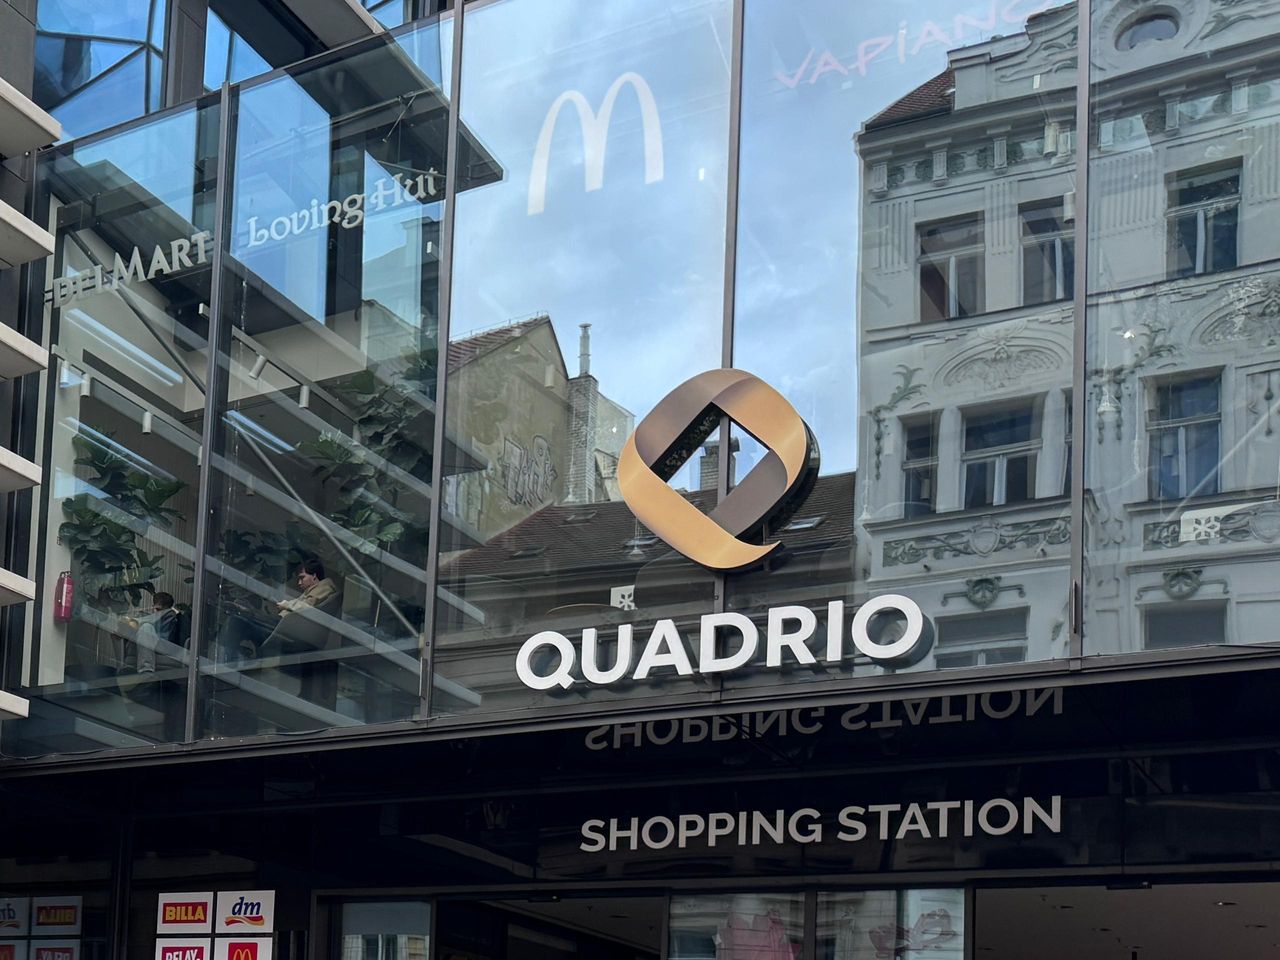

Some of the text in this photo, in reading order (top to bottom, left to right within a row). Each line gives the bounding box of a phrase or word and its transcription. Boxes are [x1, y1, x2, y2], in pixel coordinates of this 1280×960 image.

[248, 167, 439, 249] Loving Hut
[515, 594, 924, 692] QUADRIO
[579, 794, 1063, 852] SHOPPING STATION
[165, 904, 205, 921] BILLA
[232, 896, 261, 915] dm
